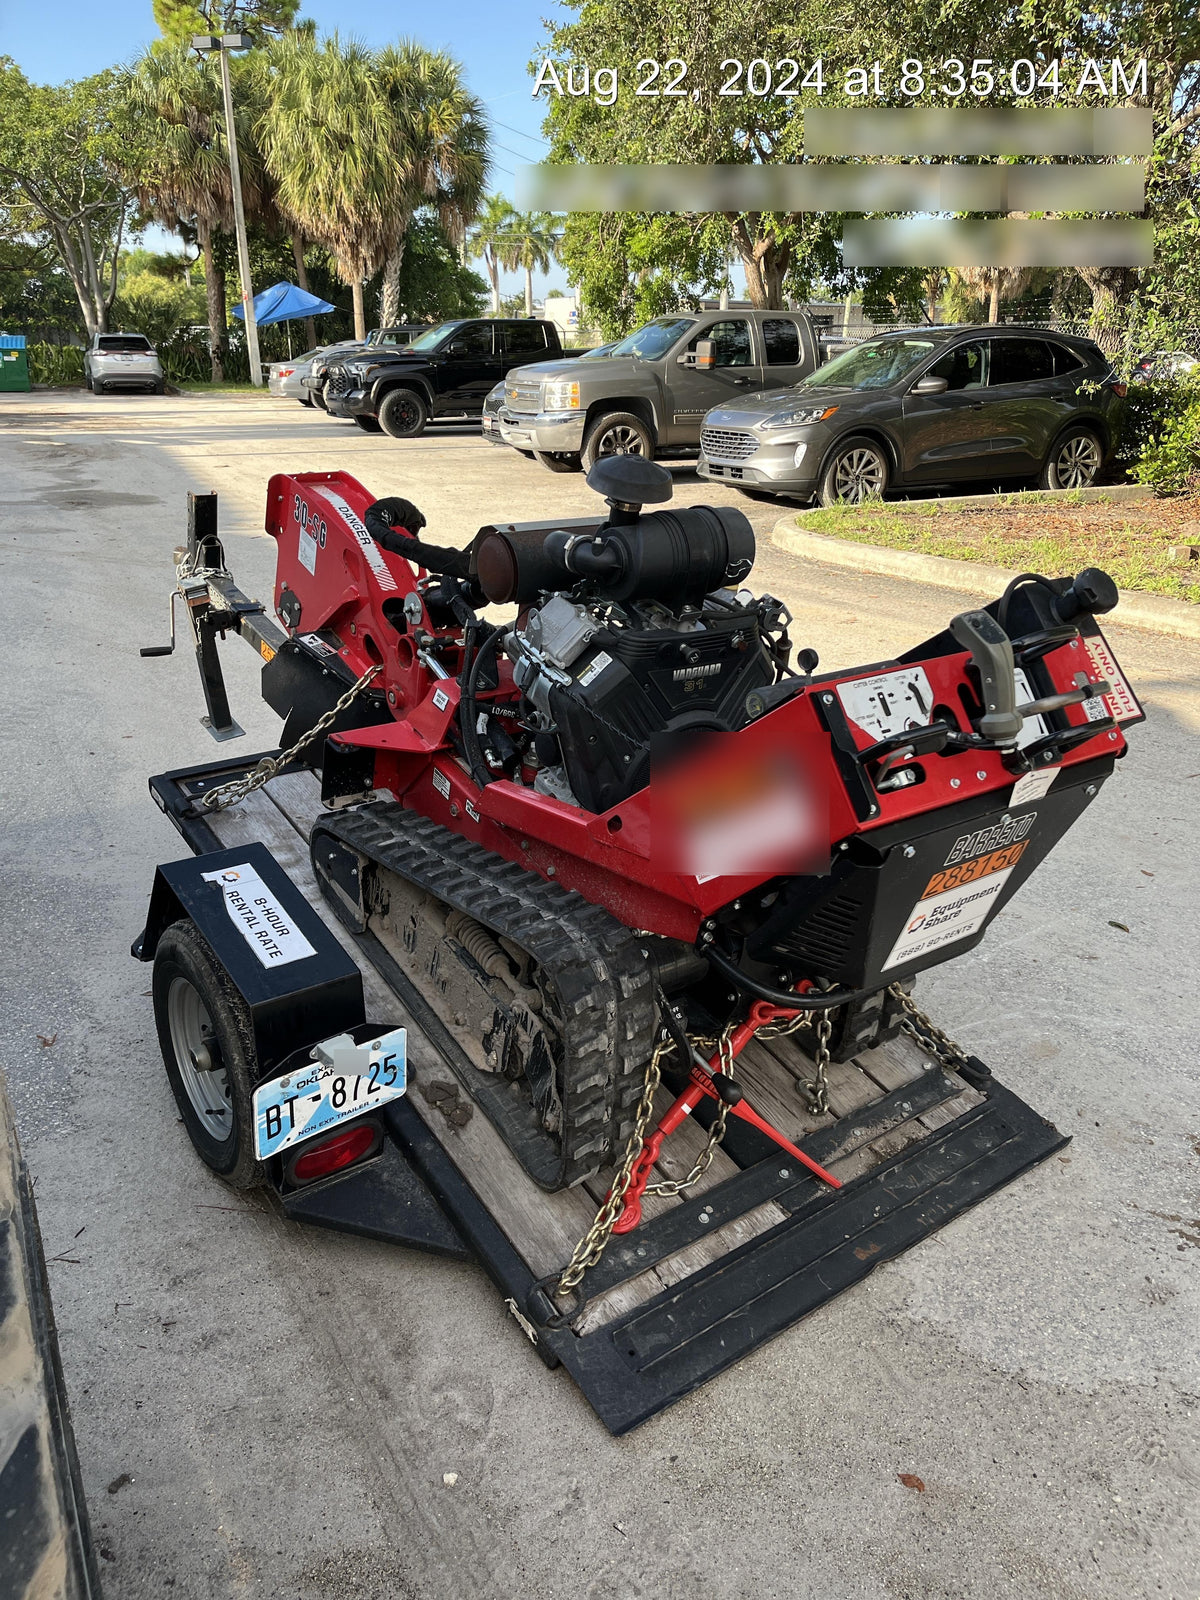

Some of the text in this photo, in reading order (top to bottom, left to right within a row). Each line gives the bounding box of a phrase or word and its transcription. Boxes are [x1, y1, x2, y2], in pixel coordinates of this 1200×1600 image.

[294, 494, 327, 549] 30-SG
[338, 506, 372, 546] DANGER
[673, 662, 722, 681] VANGUARD
[1092, 642, 1115, 676] ONLY
[1114, 678, 1135, 713] FUEL
[943, 811, 1038, 867] BARRETO
[925, 842, 1026, 897] 288150
[253, 897, 290, 937] 8-HOUR
[929, 882, 1001, 918] Equipment
[226, 890, 284, 959] RENTAL RATE
[923, 909, 962, 930] Share
[298, 1101, 370, 1136] NON EXP TRAILER
